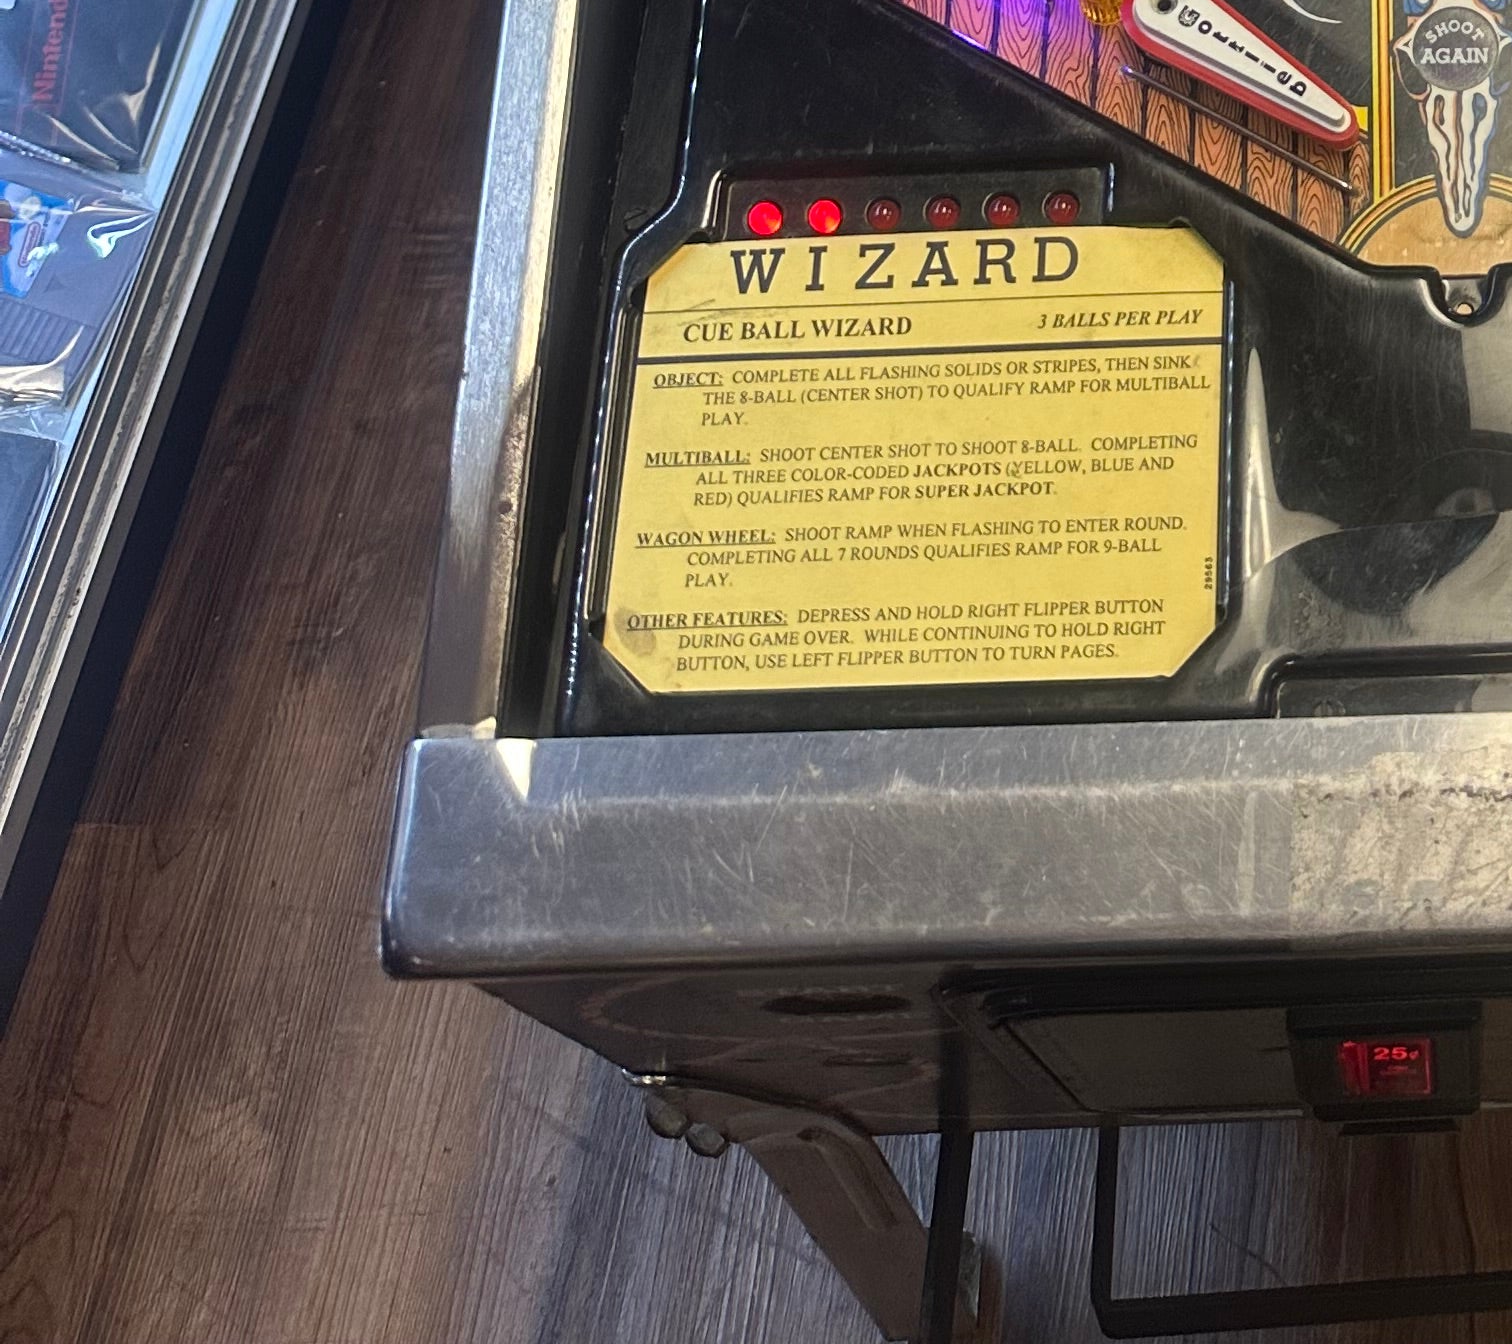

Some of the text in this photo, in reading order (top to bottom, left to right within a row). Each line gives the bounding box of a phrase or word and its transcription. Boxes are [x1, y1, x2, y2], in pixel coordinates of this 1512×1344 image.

[1425, 18, 1486, 43] SHOOT
[1420, 43, 1489, 67] AGAIN
[730, 237, 1078, 293] WIZARD
[683, 317, 912, 342] CUE BALL WIZARD
[1038, 310, 1203, 329] 3 BALLS PER PLAY
[654, 372, 723, 388] OBJECT:
[732, 369, 819, 384] COMPLETE
[824, 368, 855, 381] ALL
[860, 365, 940, 380] FLASHING
[945, 362, 1002, 377] SOLIDS
[1006, 361, 1028, 374] OR
[1105, 357, 1149, 371] THEN
[1154, 356, 1191, 370] SINK
[703, 376, 1210, 405] THE 8-BALL (CENTER SHOT) TO QUALIFY RAMP FOR MULTIBALL
[646, 450, 750, 468] MULTIBALL:
[760, 448, 816, 462] SHOOT
[820, 446, 883, 460] CENTER
[888, 444, 931, 458] SHOT
[935, 442, 957, 456] TO
[962, 441, 1017, 455] SHOOT
[1091, 435, 1197, 451] COMPLETING
[696, 471, 728, 485] ALL
[733, 469, 786, 484] THREE
[791, 465, 909, 482] COLOR-CODED
[913, 462, 1001, 477] JACKPOTS
[1092, 458, 1134, 472] BLUE
[1139, 457, 1174, 470] AND
[694, 492, 732, 506] RED)
[737, 489, 823, 506] QUALIFIES
[828, 487, 874, 501] RAMP
[879, 486, 910, 500] FOR
[915, 484, 969, 499] SUPER
